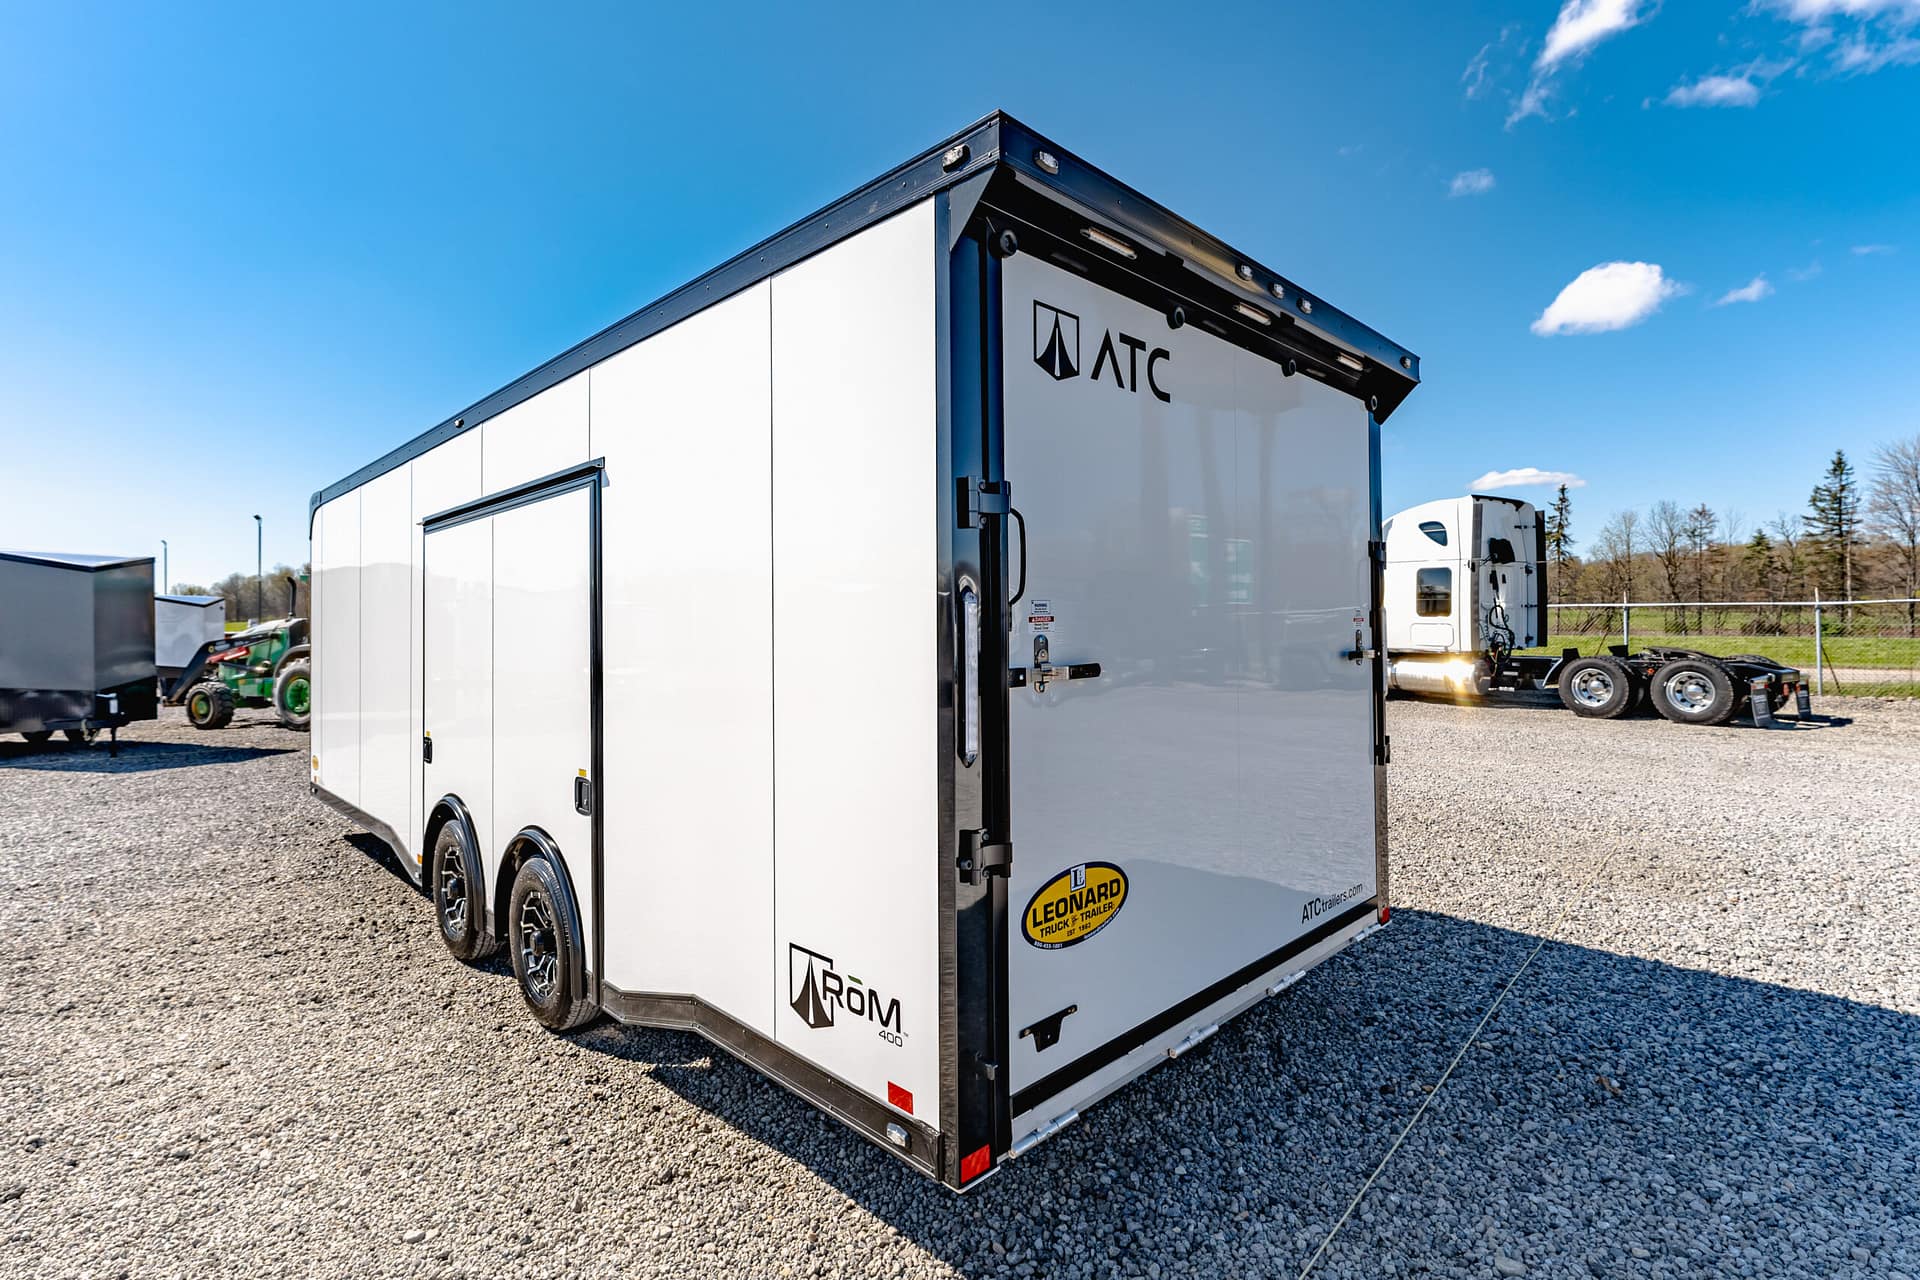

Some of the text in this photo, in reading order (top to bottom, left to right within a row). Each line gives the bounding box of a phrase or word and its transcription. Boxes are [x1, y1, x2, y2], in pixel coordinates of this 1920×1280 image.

[1090, 328, 1171, 403] ATC
[1032, 878, 1121, 928] LEONARD
[1040, 918, 1069, 938] TRUCK
[1080, 901, 1113, 922] TRAILER
[1301, 883, 1363, 924] ATCtrailers.com
[878, 1030, 903, 1047] 400
